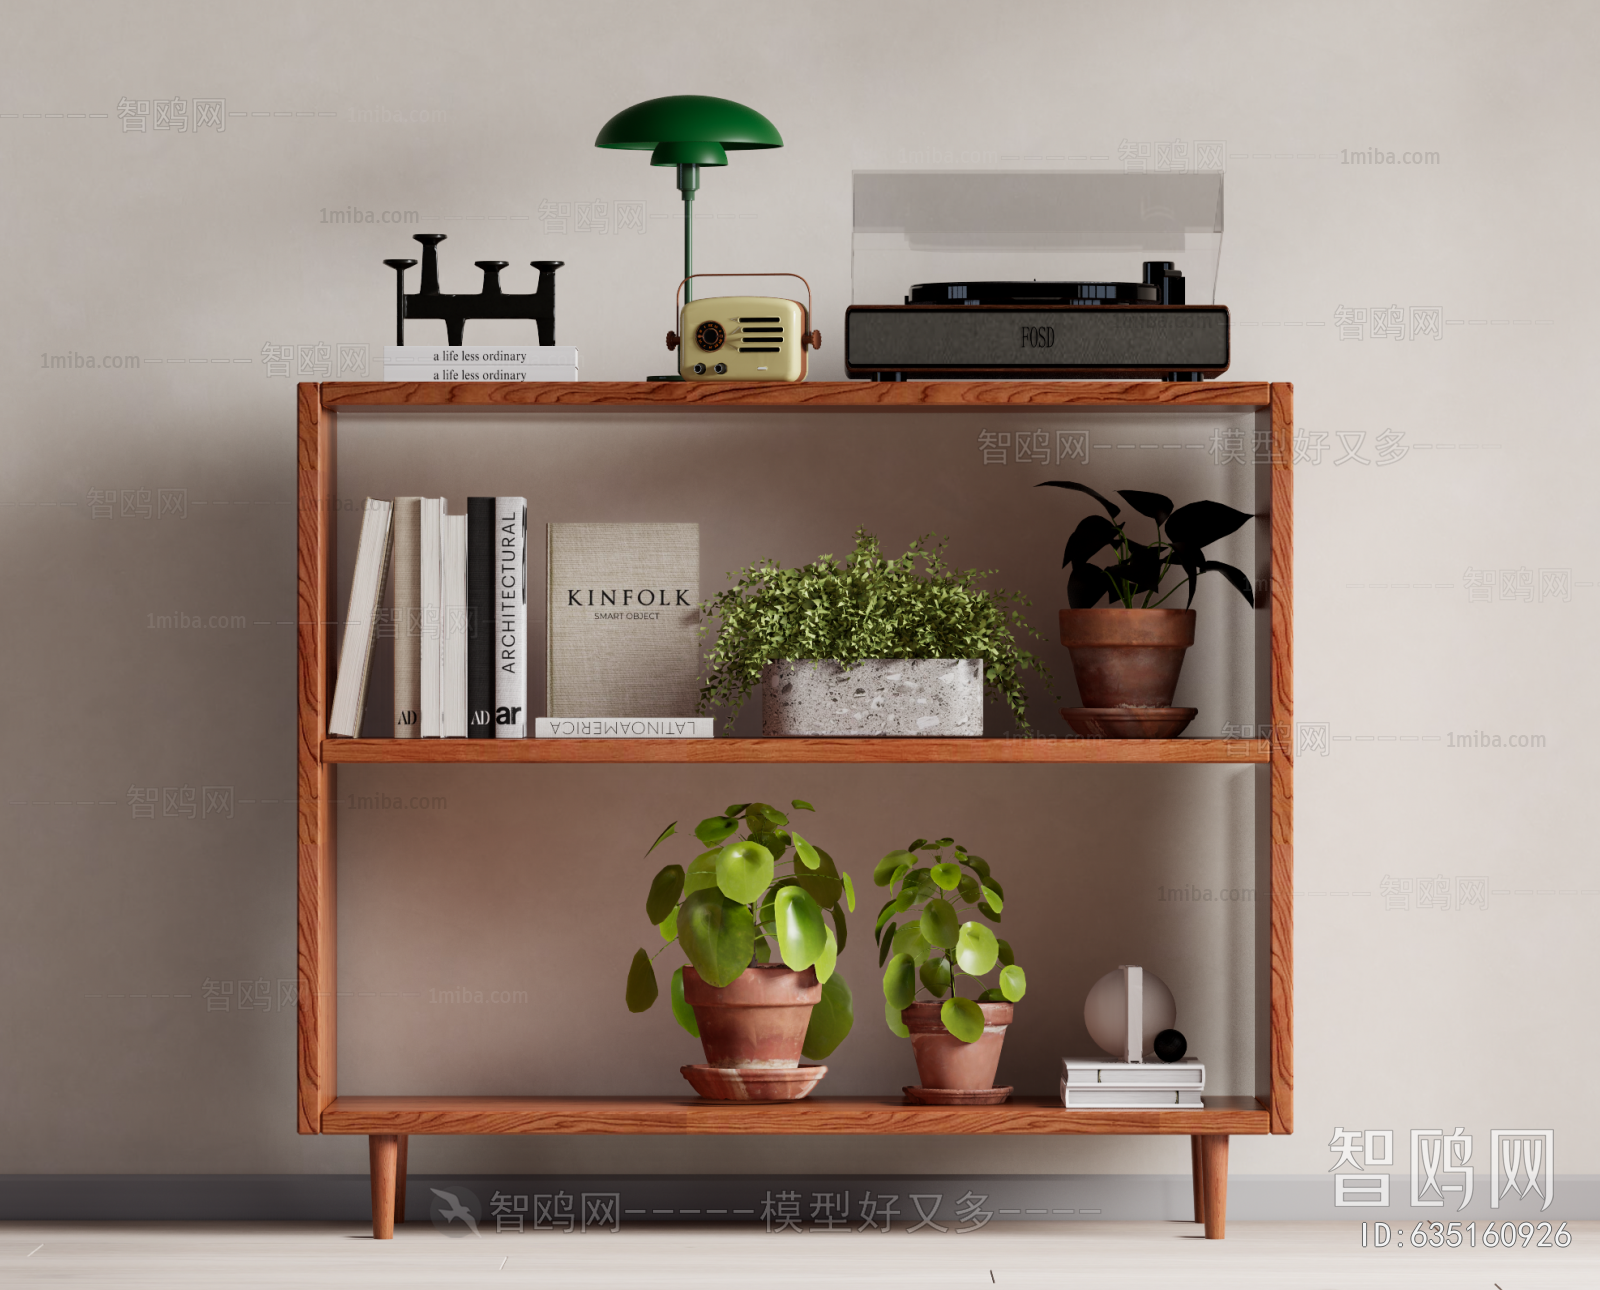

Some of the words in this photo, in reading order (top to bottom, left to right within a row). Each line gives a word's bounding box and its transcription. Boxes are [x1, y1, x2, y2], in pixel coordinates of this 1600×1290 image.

[1021, 326, 1055, 348] FOSD
[433, 353, 440, 361] a
[442, 350, 459, 361] life
[461, 350, 480, 361] less
[482, 350, 527, 363] ordinary
[433, 372, 440, 380] a
[442, 369, 459, 380] life
[461, 369, 480, 380] less
[482, 369, 527, 382] ordinary
[501, 511, 516, 673] ARCHITECTURAL
[568, 589, 691, 606] KINFOLK
[594, 612, 623, 620] SMART
[626, 612, 660, 620] OBJECT
[397, 710, 417, 725] AD
[470, 710, 491, 725] AD
[496, 706, 521, 725] ar
[549, 721, 696, 735] LATINOAMERICA
